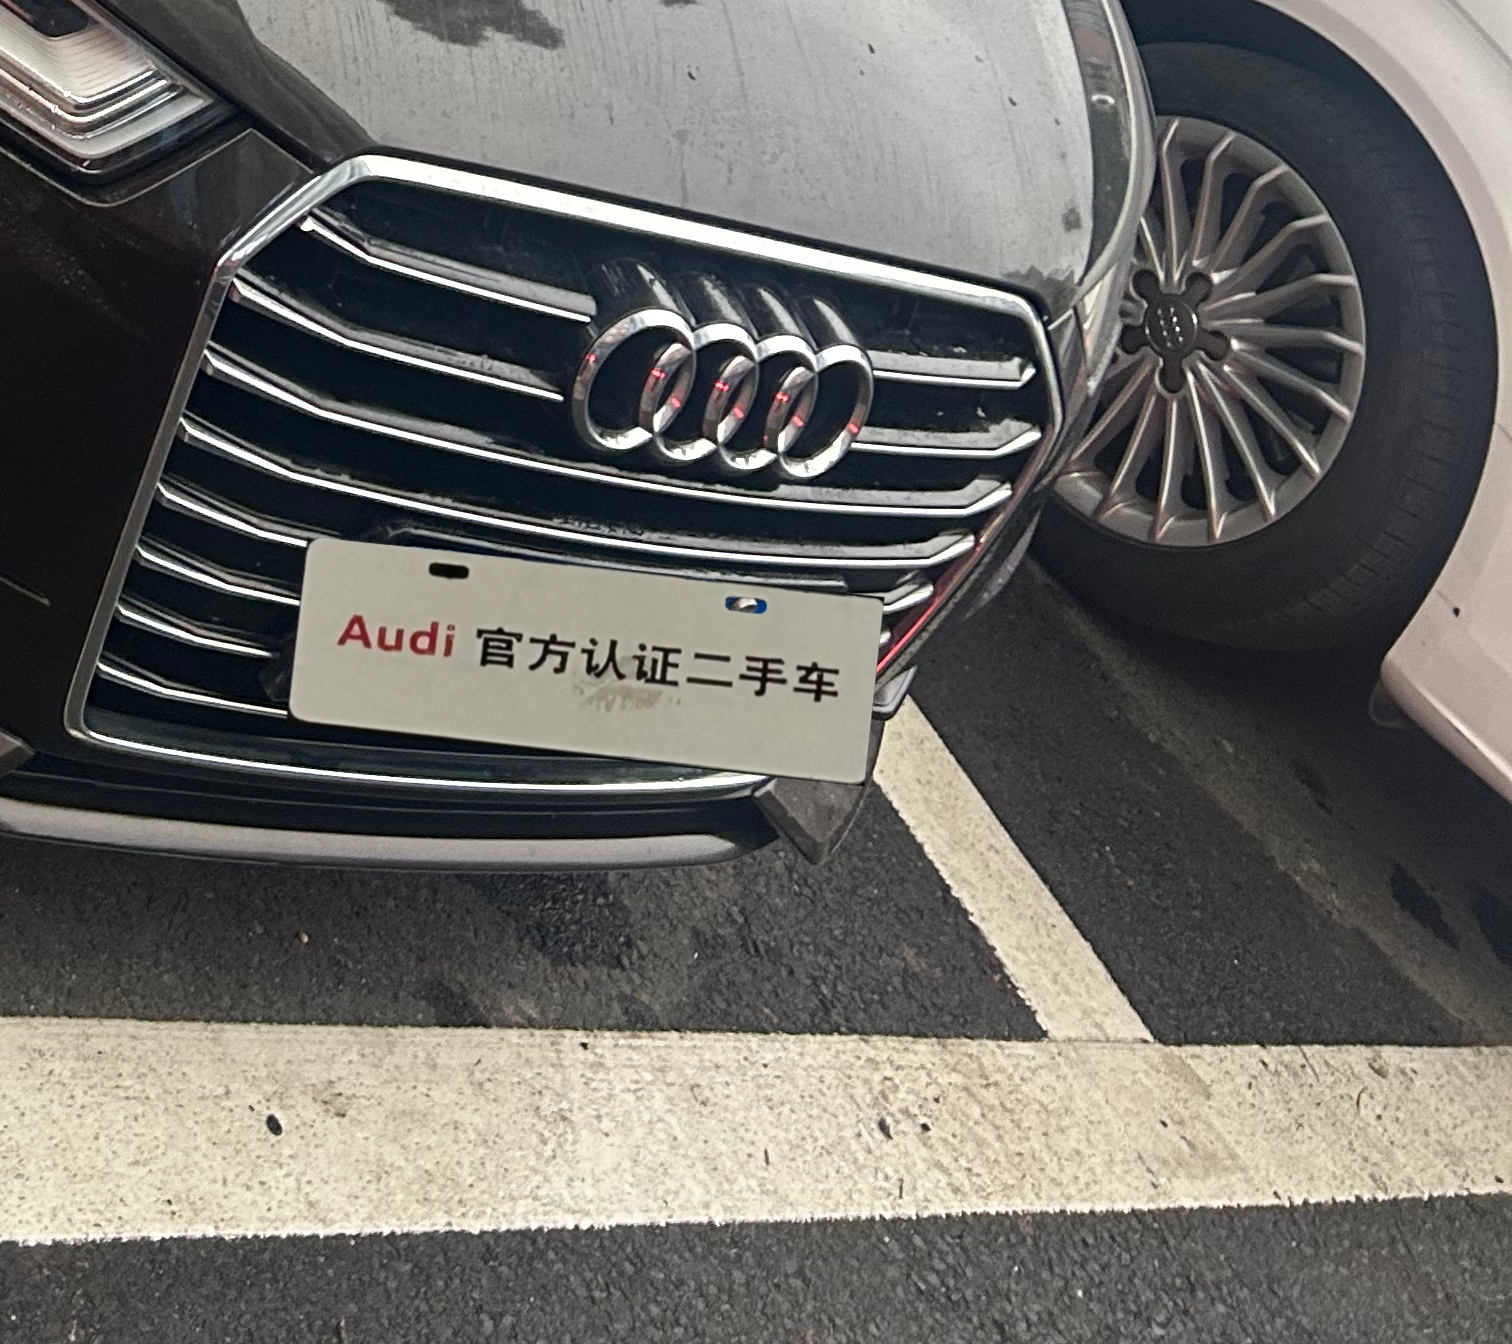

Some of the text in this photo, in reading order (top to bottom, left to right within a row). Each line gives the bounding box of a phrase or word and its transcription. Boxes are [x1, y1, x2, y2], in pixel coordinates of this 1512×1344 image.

[337, 615, 841, 703] Audi 官方认证二手车
